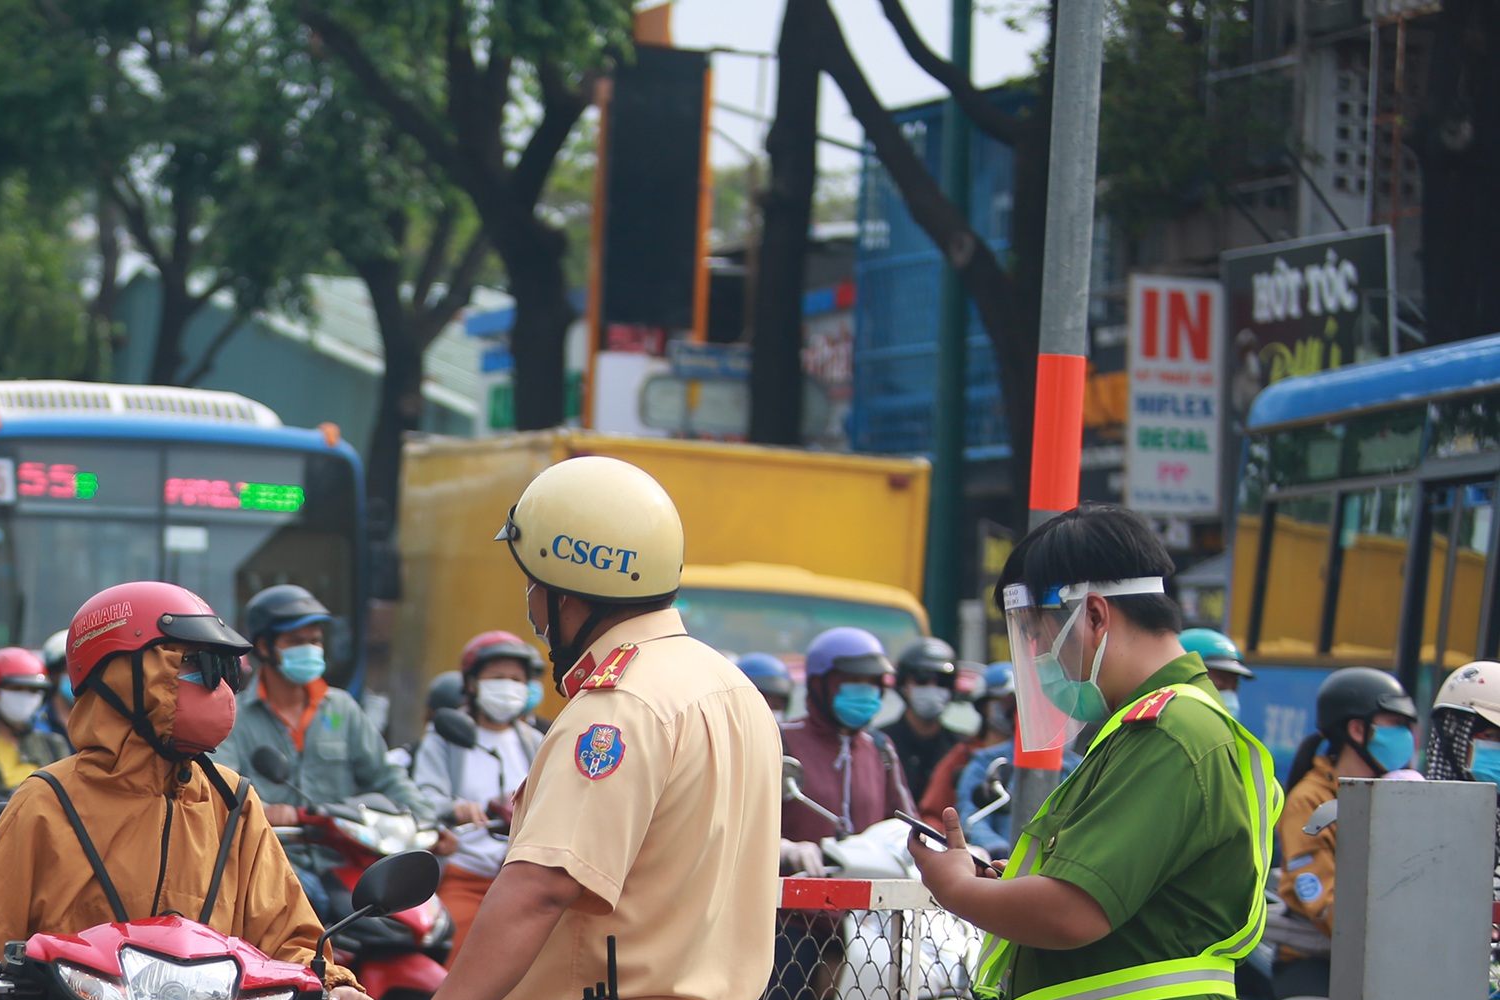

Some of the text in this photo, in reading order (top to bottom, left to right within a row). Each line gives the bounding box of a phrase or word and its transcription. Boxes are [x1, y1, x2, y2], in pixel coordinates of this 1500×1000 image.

[1141, 286, 1212, 362] IN
[1137, 425, 1211, 454] DECAL
[552, 535, 637, 574] CSGT
[73, 600, 133, 637] YAMAHA
[580, 750, 615, 766] CSGT
